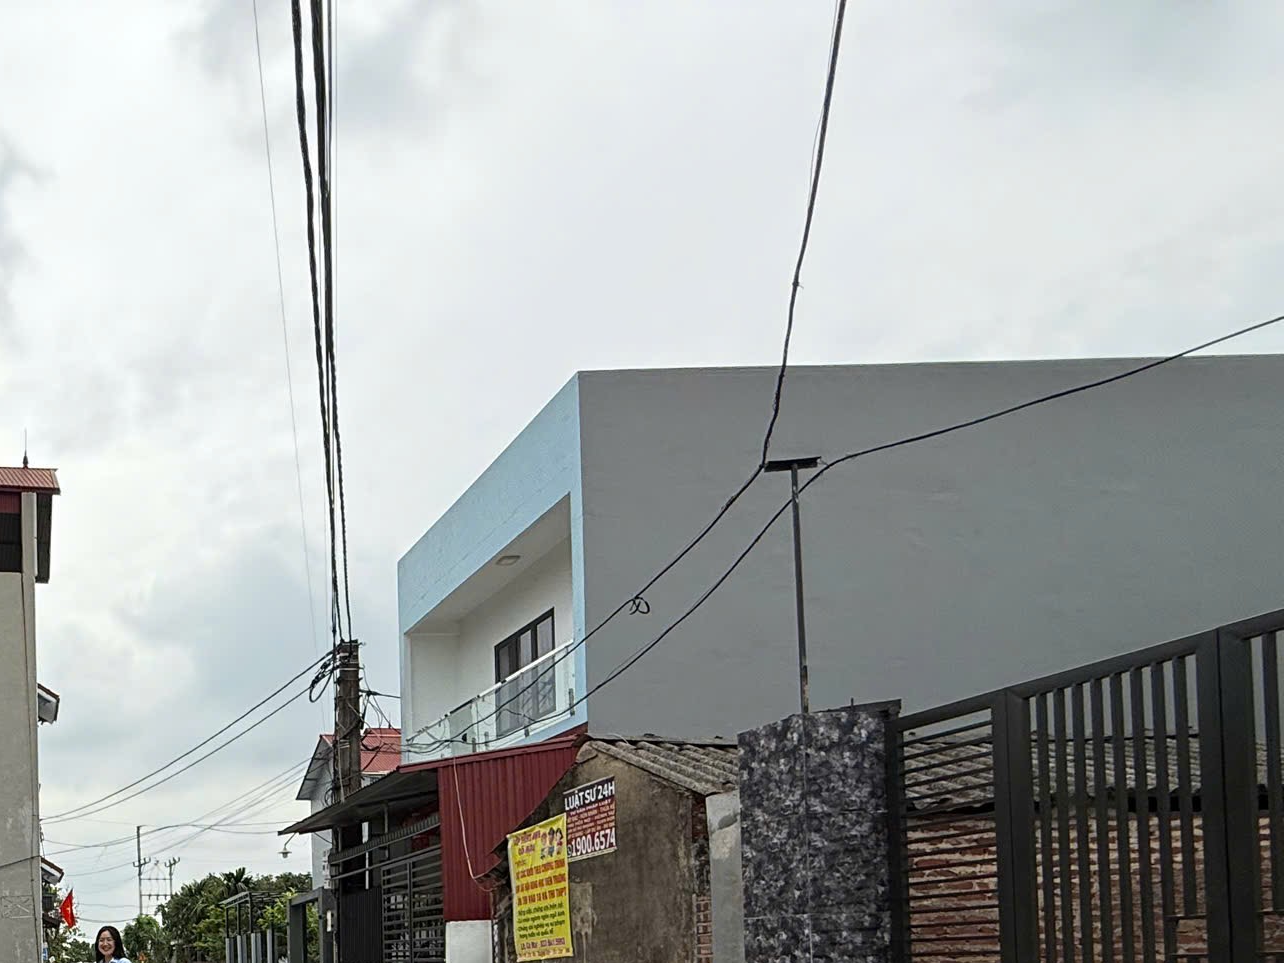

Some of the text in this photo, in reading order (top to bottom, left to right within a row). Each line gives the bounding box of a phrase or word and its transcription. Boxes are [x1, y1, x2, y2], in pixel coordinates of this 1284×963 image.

[565, 790, 584, 811] LUẬT
[598, 781, 615, 799] 24H
[572, 828, 616, 856] 1900.6574
